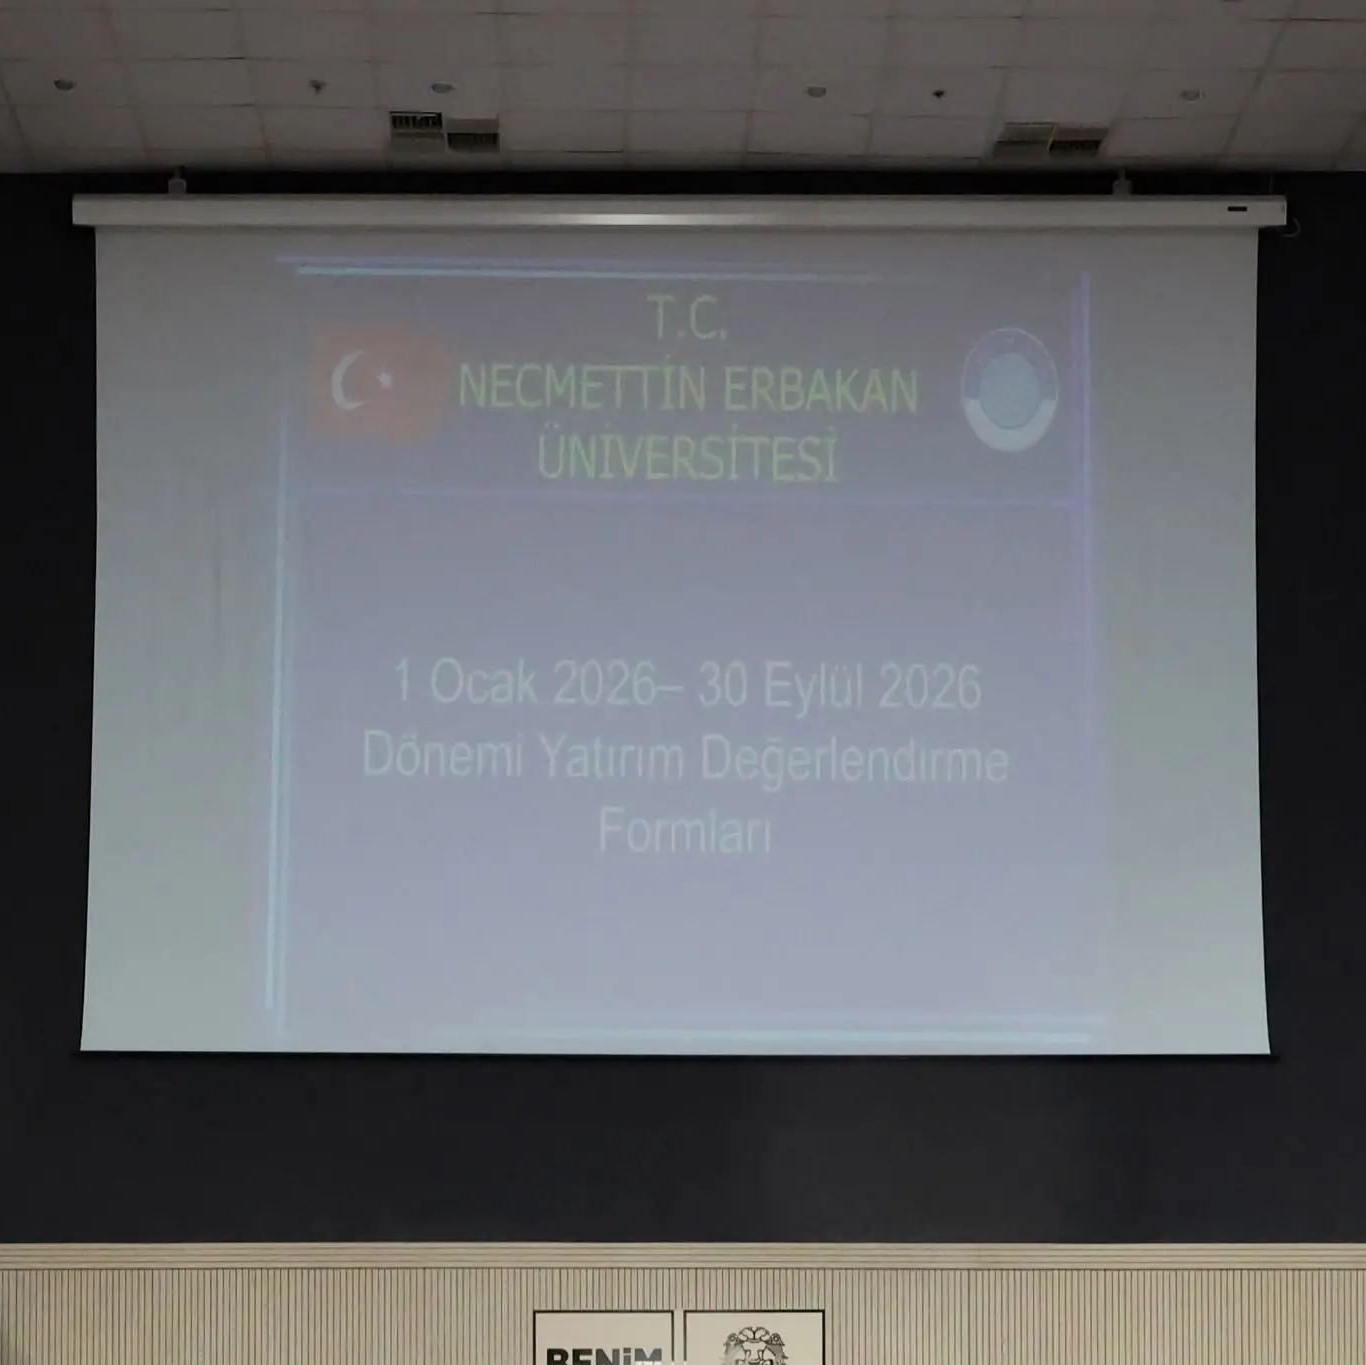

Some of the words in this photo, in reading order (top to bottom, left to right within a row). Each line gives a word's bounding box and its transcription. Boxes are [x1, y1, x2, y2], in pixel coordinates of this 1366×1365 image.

[646, 293, 727, 341] T.C.
[459, 353, 706, 411] NECMETTİN
[724, 364, 918, 414] ERBAKAN
[538, 421, 839, 483] ÜNİVERSİTESİ
[393, 657, 409, 702] 1
[430, 656, 536, 706] Ocak
[698, 660, 747, 707] 30
[765, 660, 864, 719] Eylül
[879, 662, 983, 710] 2026
[364, 728, 523, 777] Dönemi
[539, 730, 683, 779] Yatırım
[701, 733, 1010, 792] Değerlendirme
[599, 805, 771, 853] Formları
